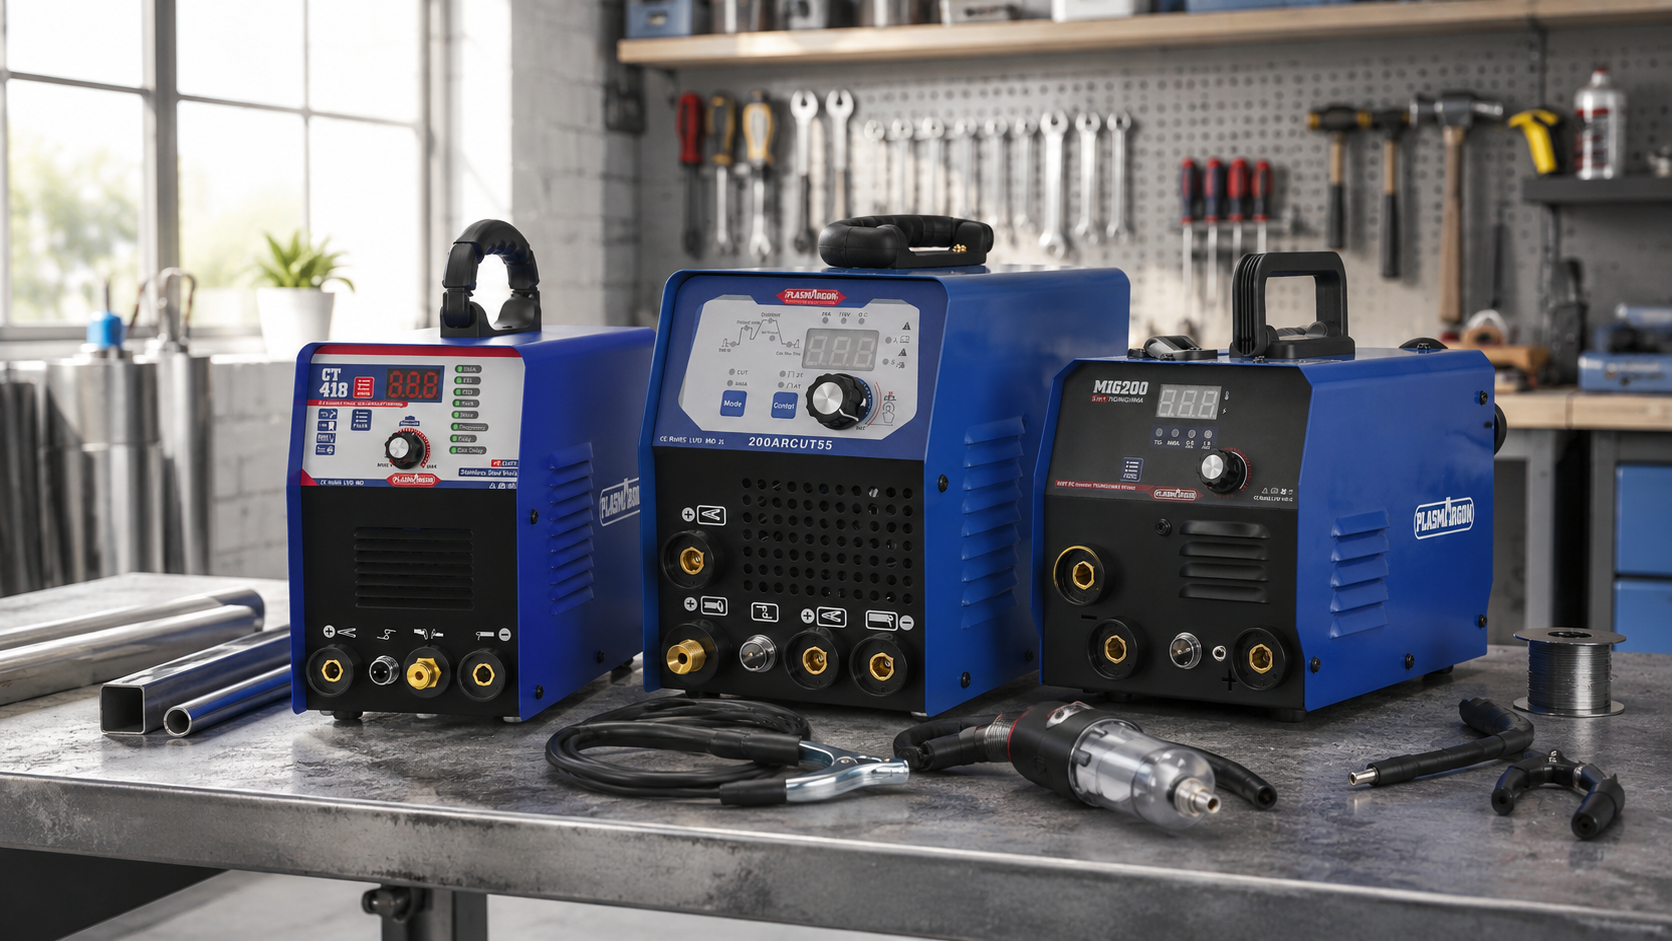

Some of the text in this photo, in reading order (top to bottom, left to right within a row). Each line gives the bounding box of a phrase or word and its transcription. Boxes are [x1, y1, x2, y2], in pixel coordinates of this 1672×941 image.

[321, 367, 341, 381] CT
[319, 382, 348, 397] 418
[1092, 379, 1149, 395] MIG200
[723, 399, 742, 408] Mode
[748, 436, 833, 451] 200ARCUT55
[1416, 497, 1473, 533] PLASMARGON
